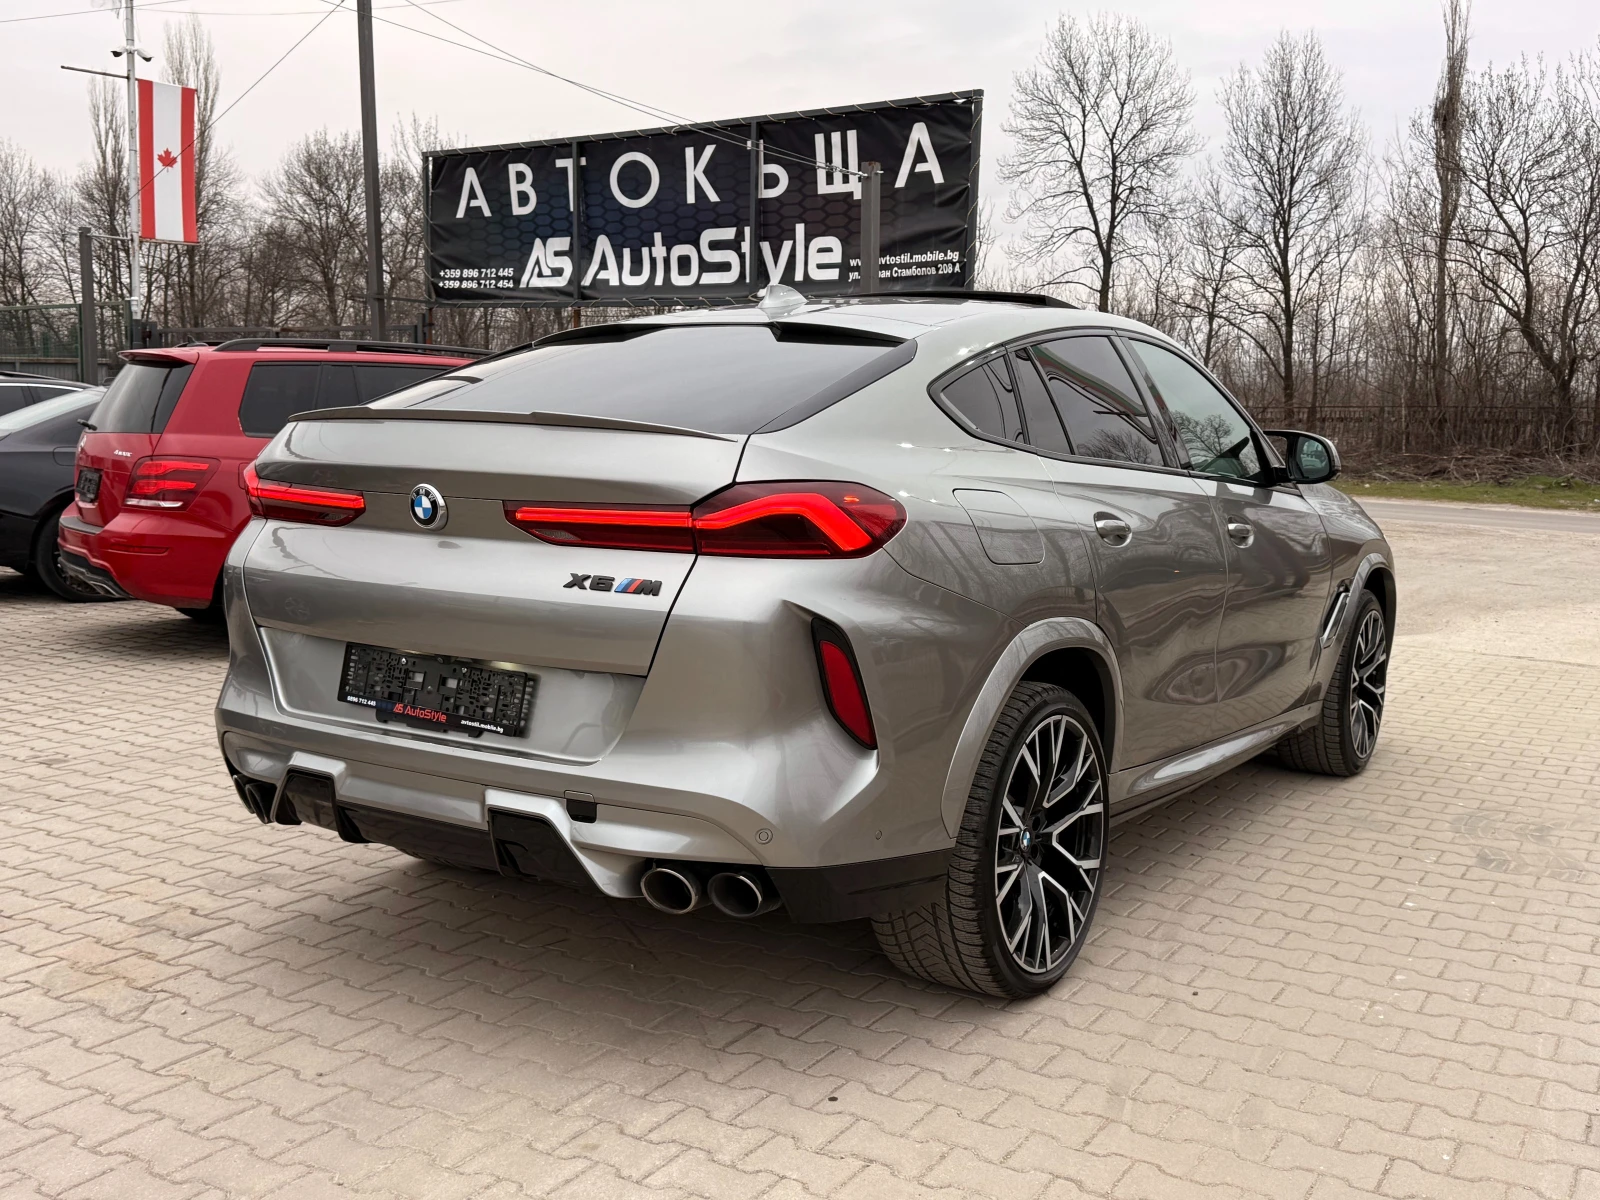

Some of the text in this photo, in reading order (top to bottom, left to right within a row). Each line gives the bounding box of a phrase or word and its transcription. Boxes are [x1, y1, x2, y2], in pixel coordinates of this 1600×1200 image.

[519, 223, 842, 297] AS AutoStyle
[439, 267, 514, 278] +359 896 712 445
[848, 271, 861, 282] ул.
[892, 265, 937, 278] Стамболов
[937, 262, 953, 275] 208
[438, 279, 514, 289] +359 896 712 454
[411, 488, 437, 502] BMW
[562, 572, 616, 593] X6
[347, 695, 359, 703] 0896
[359, 697, 368, 705] 712
[393, 703, 447, 723] AS AutoStyle
